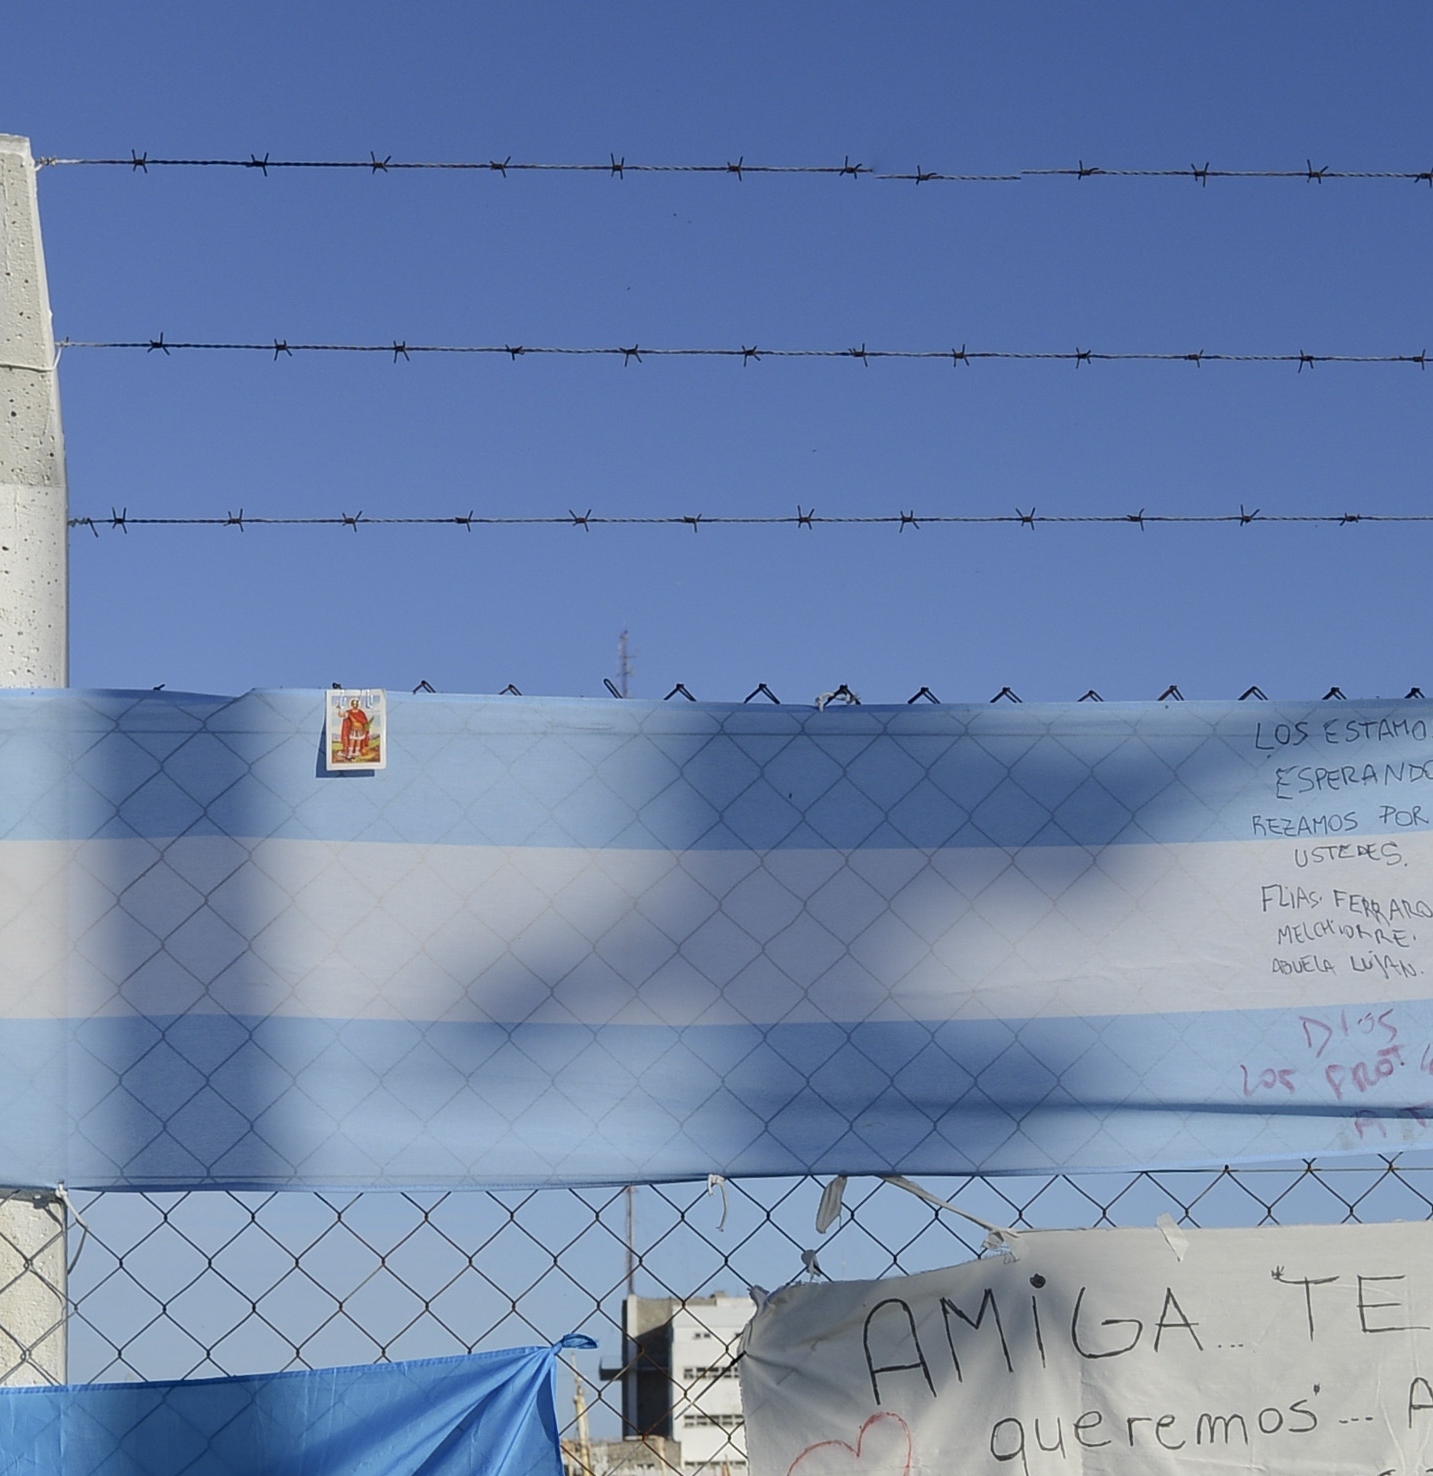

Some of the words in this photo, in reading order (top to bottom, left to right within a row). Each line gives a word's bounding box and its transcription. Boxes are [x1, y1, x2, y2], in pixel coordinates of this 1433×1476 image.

[1255, 721, 1309, 750] LOS
[1252, 811, 1359, 837] REZAMOS
[1379, 805, 1430, 827] POR
[1294, 841, 1408, 868] USTEDES.
[1333, 889, 1433, 927] FERRARO
[1272, 1272, 1431, 1342] TE
